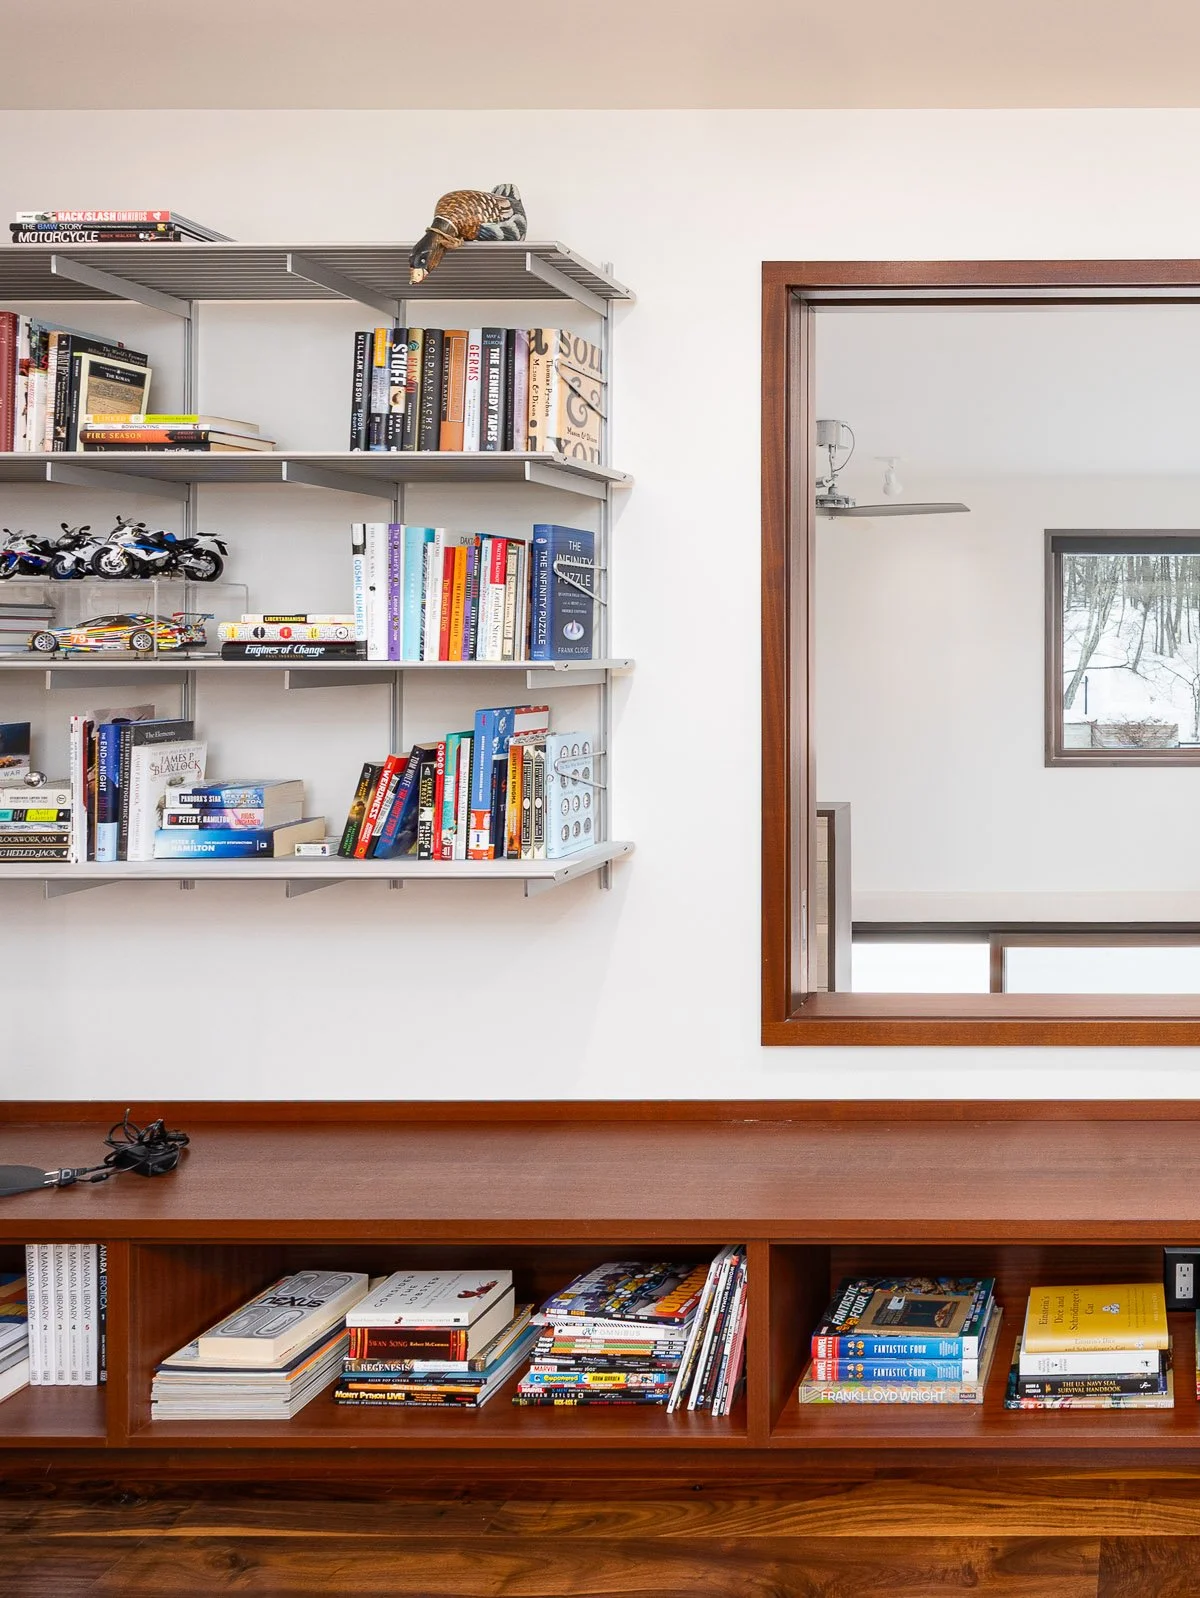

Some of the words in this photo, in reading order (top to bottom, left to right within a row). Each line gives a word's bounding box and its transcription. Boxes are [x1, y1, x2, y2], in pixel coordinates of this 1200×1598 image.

[57, 212, 116, 221] HACK/SLASH
[117, 212, 147, 221] OMNIBUS
[152, 212, 162, 220] 4
[18, 232, 98, 243] MOTORCYCLE
[356, 335, 364, 370] WILLIAM
[390, 343, 408, 385] STUFF
[468, 344, 479, 381] GERMS
[488, 348, 500, 366] THE
[427, 339, 436, 392] GOLDMAN
[355, 372, 363, 402] GIBSON
[487, 368, 500, 411] KENNEDY
[425, 396, 433, 430] SACHS
[487, 414, 498, 441] TAPES
[539, 550, 548, 567] THE
[353, 559, 363, 589] COSMIC
[442, 579, 450, 589] The
[539, 570, 547, 608] INFINITY
[354, 591, 364, 636] NUMBERS
[441, 591, 450, 613] Broken
[492, 587, 502, 622] Lombard
[492, 625, 501, 648] Street
[538, 610, 546, 644] PUZZLE
[71, 635, 87, 643] 79
[245, 645, 279, 655] Engines
[281, 645, 292, 655] of
[293, 645, 325, 656] Change
[99, 740, 107, 758] END
[409, 755, 419, 769] TOM
[99, 766, 107, 791] NIGHT
[401, 767, 414, 787] WOLFE
[369, 770, 390, 819] WEIRDNESS
[397, 788, 407, 800] THE
[392, 800, 405, 817] RIGHT
[384, 818, 397, 837] STUFF
[83, 1252, 91, 1288] MANARA
[374, 1274, 416, 1308] CONSIDER
[400, 1284, 418, 1297] THE
[405, 1276, 440, 1305] LOBSTER
[1055, 1295, 1064, 1309] and
[83, 1290, 91, 1320] LIBRARY
[831, 1284, 859, 1328] FANTASTIC
[849, 1292, 867, 1320] FOUR
[1039, 1295, 1049, 1327] Einstein's
[1070, 1288, 1080, 1331] Schrödinger's
[1085, 1302, 1094, 1318] Cat
[1055, 1311, 1064, 1328] Dice
[874, 1344, 907, 1354] FANTASTIC
[909, 1344, 927, 1354] FOUR
[361, 1362, 410, 1372] REGENESIS
[873, 1367, 907, 1377] FANTASTIC
[909, 1368, 927, 1377] FOUR
[335, 1391, 358, 1399] MONTY
[387, 1392, 405, 1400] LIVE!
[821, 1391, 857, 1401] FRANK
[859, 1391, 894, 1401] LLOYD
[897, 1391, 946, 1402] WRIGHT
